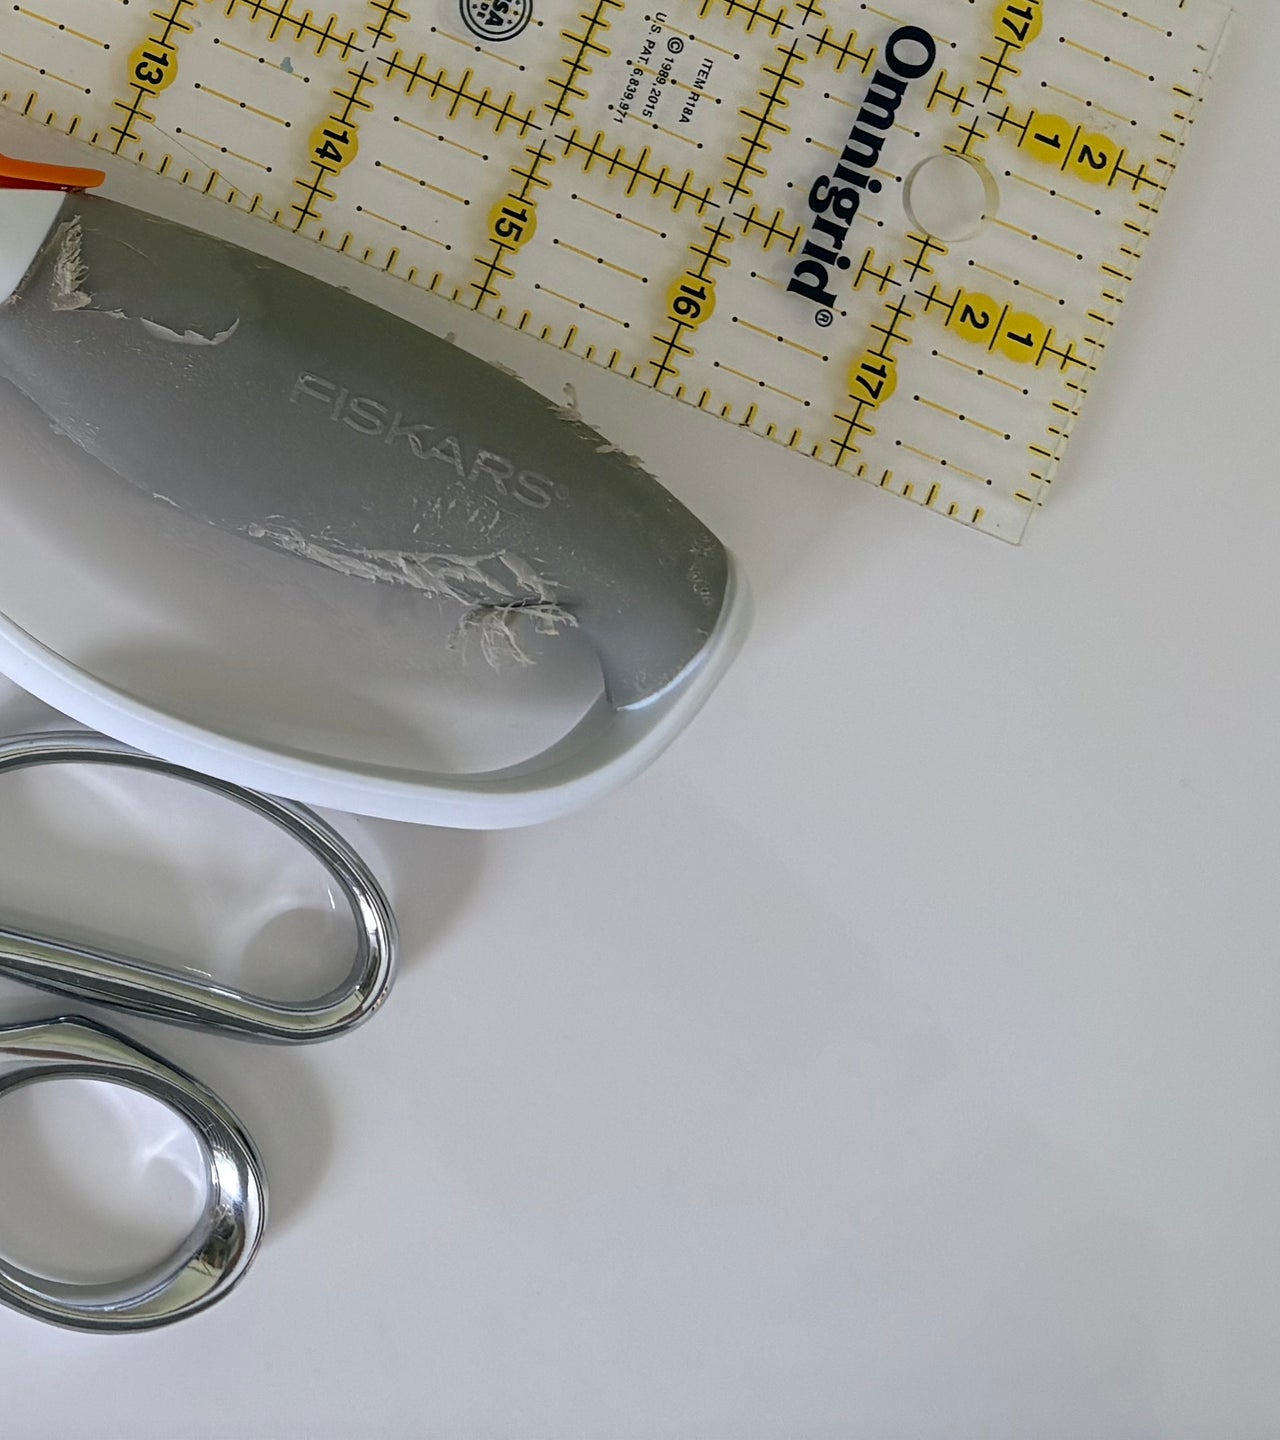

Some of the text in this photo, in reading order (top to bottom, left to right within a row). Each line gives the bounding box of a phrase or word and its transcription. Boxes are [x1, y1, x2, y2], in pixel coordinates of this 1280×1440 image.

[1001, 4, 1034, 42] 17
[134, 51, 170, 85] 13
[636, 38, 656, 65] PAT.
[613, 67, 644, 124] 6,839,971
[678, 57, 714, 124] ITEM R18A
[314, 128, 350, 163] 14
[1033, 132, 1061, 150] 1
[1077, 144, 1108, 170] 2
[494, 207, 528, 243] 15
[672, 284, 707, 319] 16
[959, 303, 990, 330] 2
[1006, 331, 1034, 348] 1
[855, 362, 888, 400] 17
